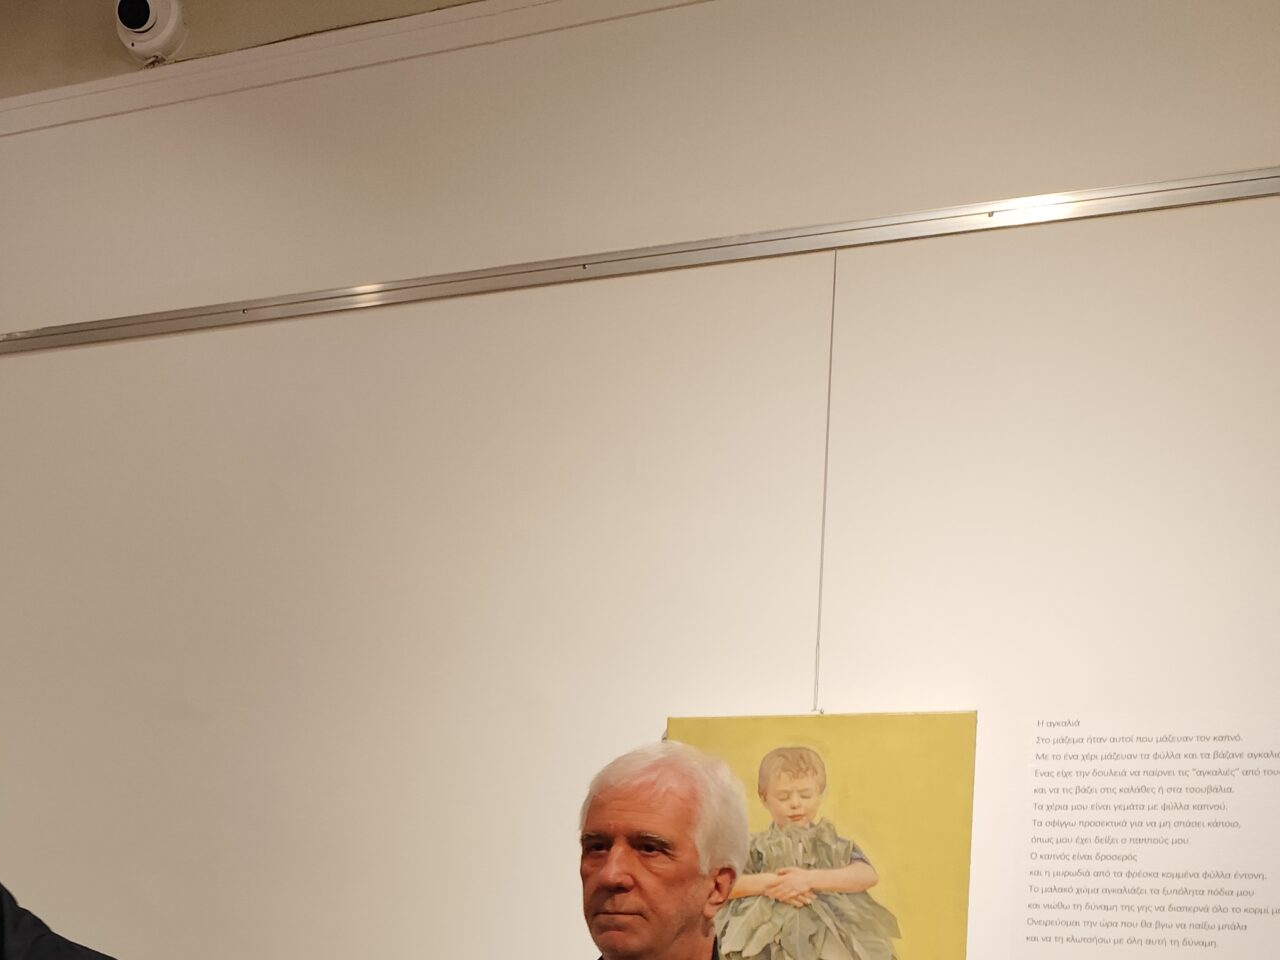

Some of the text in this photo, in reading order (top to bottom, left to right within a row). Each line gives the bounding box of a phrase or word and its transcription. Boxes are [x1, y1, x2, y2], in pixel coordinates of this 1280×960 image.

[1046, 719, 1081, 728] αγκαλιά
[1036, 736, 1051, 744] Στο
[1052, 736, 1084, 745] μάζεμα
[1086, 736, 1108, 744] ήταν
[1155, 734, 1194, 744] μάζευαν
[1063, 752, 1079, 760] ένα
[1080, 752, 1098, 762] χέρι
[1100, 752, 1138, 761] μάζευαν
[1152, 751, 1182, 760] φύλλα
[1212, 750, 1244, 760] βάζανε
[1056, 770, 1073, 778] είχε
[1091, 769, 1127, 777] δουλειά
[1143, 768, 1175, 777] παίρνει
[1241, 768, 1261, 776] από
[1074, 786, 1098, 795] βάζει
[1099, 787, 1117, 795] στις
[1185, 784, 1235, 795] τσουβάλια.
[1046, 803, 1069, 812] χέρια
[1113, 803, 1145, 812] γεμάτα
[1160, 802, 1190, 811] φύλλα
[1192, 802, 1228, 810] καπνού.
[1044, 819, 1077, 828] σφίγγω
[1078, 819, 1127, 828] προσεκτικά
[1129, 821, 1143, 829] για
[1173, 819, 1205, 828] σπάσει
[1030, 836, 1054, 845] όπως
[1055, 837, 1073, 845] μου
[1075, 836, 1092, 845] έχει
[1094, 836, 1119, 845] δείξει
[1129, 836, 1169, 845] παππούς
[1039, 852, 1070, 861] καπνός
[1072, 852, 1093, 861] είναι
[1052, 869, 1091, 878] μυρωδιά
[1092, 870, 1111, 878] από
[1125, 870, 1159, 879] φρέσκα
[1161, 871, 1200, 879] κομμένα
[1202, 871, 1231, 880] φύλλα
[1041, 885, 1074, 894] μαλακό
[1101, 886, 1147, 896] αγκαλιάζει
[1207, 888, 1234, 896] πόδια
[1042, 902, 1070, 910] νιώθω
[1084, 902, 1118, 912] δύναμη
[1167, 904, 1210, 913] διαπερνά
[1212, 905, 1229, 913] όλο
[1243, 906, 1269, 915] κορμί
[1099, 920, 1118, 928] ώρα
[1188, 921, 1216, 931] παίξω
[1217, 922, 1248, 931] μπάλα
[1126, 936, 1143, 946] όλη
[1145, 937, 1167, 947] αυτή
